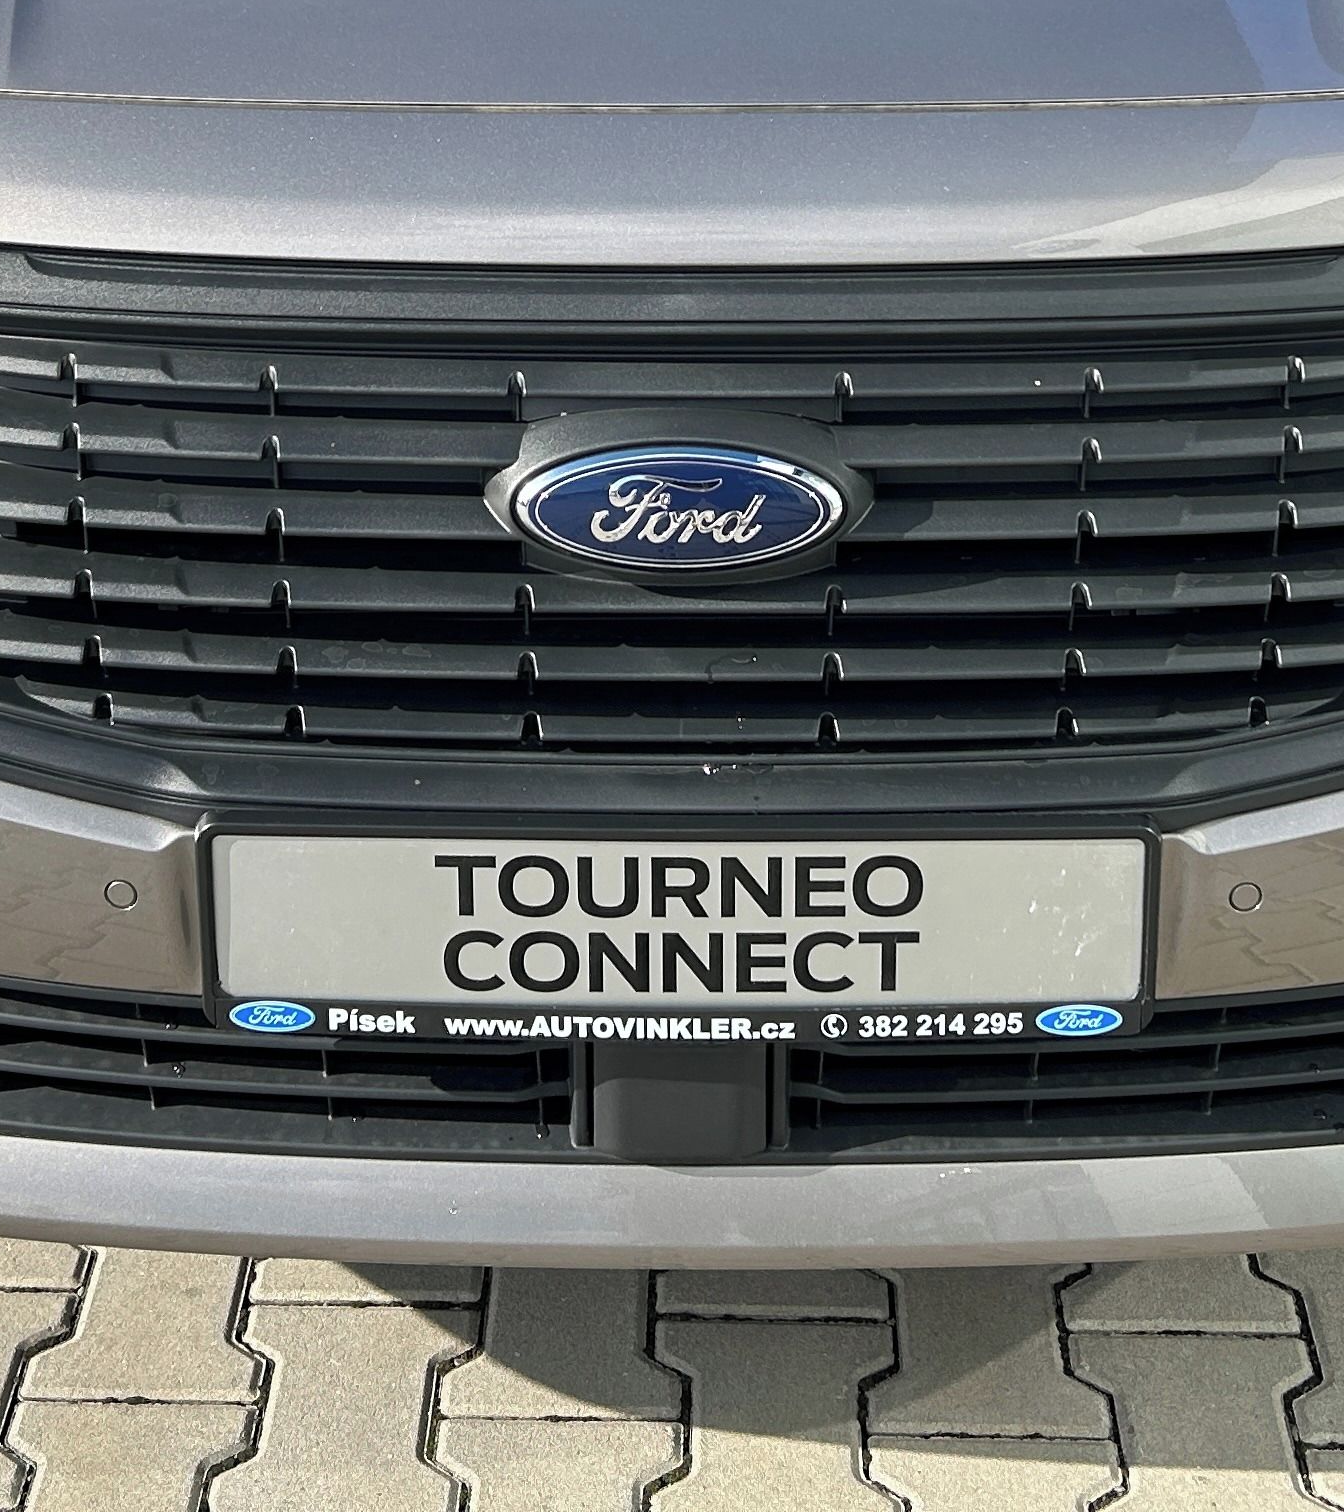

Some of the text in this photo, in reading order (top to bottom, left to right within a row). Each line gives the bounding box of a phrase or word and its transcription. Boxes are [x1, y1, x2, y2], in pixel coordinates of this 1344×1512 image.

[590, 474, 767, 544] Ford
[434, 855, 924, 919] TOURNEO
[443, 930, 921, 993] CONNECT
[248, 1005, 1104, 1040] Ford Písek www.AUTOVINKLER.cz 382 214 295 Ford
